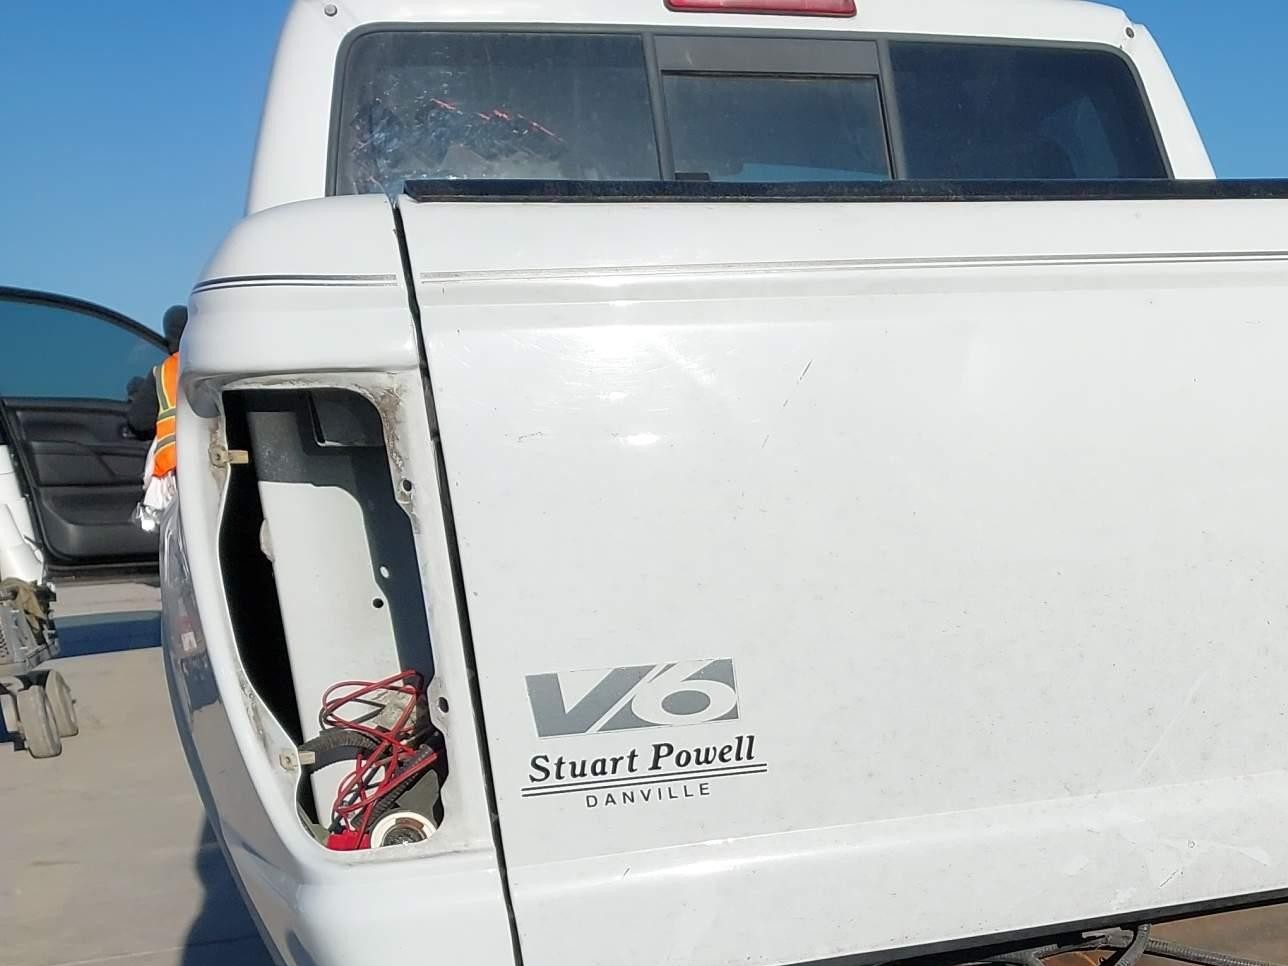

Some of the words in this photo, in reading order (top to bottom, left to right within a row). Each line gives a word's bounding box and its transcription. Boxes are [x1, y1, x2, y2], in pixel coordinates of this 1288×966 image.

[525, 657, 739, 738] V6
[529, 748, 639, 783] Stuart
[648, 735, 756, 771] Powell
[586, 782, 711, 808] DANVILLE
